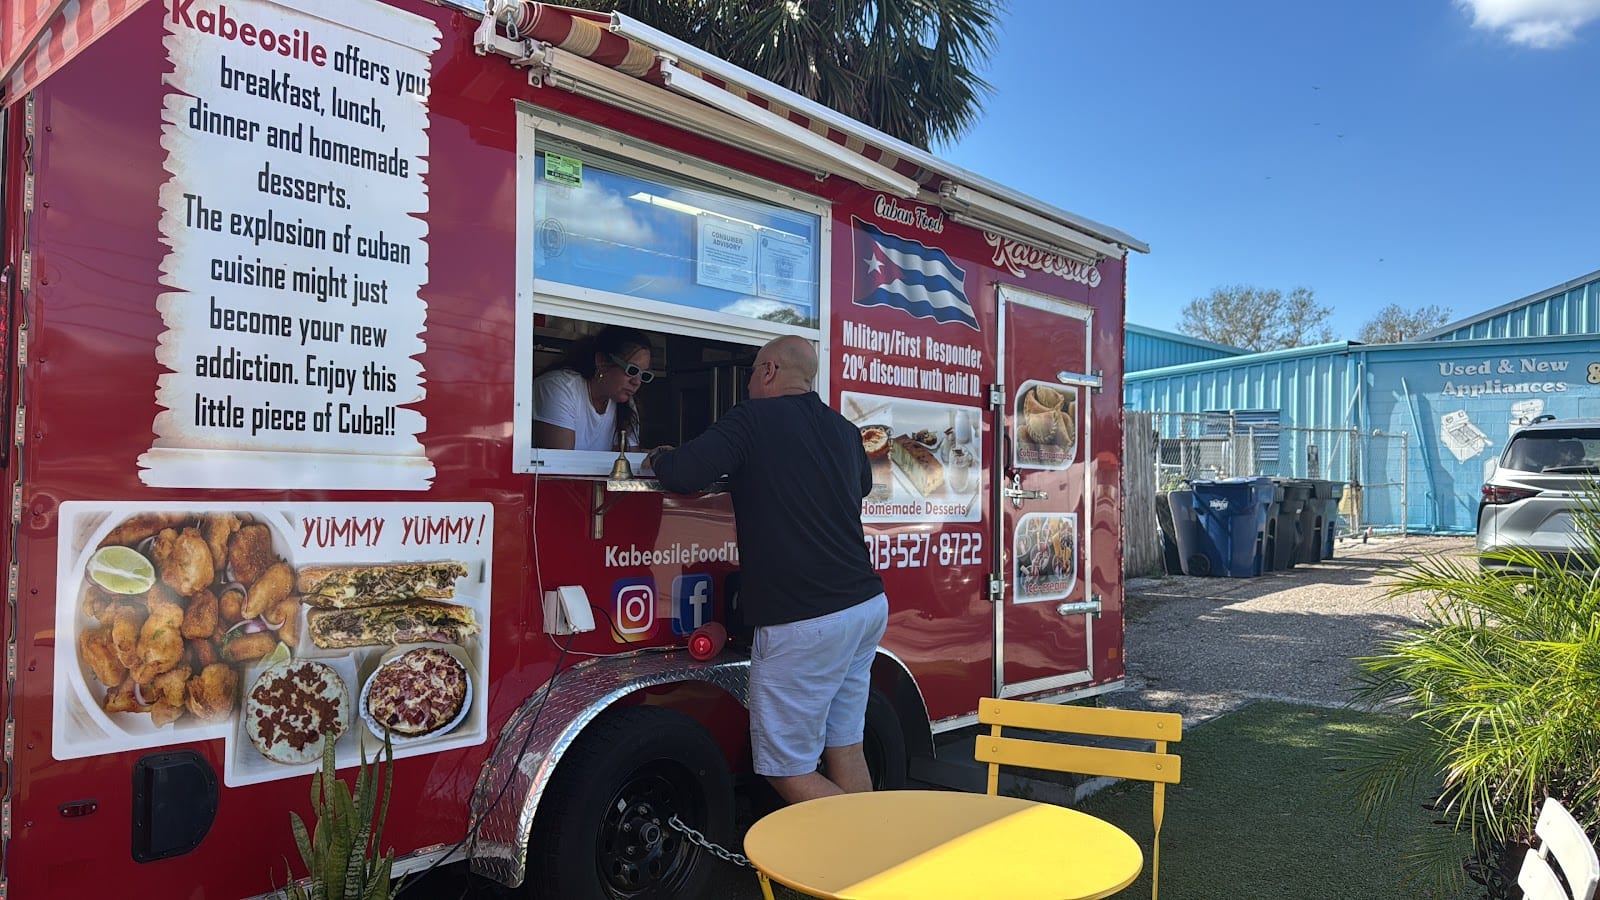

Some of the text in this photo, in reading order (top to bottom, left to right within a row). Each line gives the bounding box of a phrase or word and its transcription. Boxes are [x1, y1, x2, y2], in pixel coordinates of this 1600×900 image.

[172, 0, 426, 97] Kabeosile offers you
[220, 55, 386, 133] breakfast, lunch,
[189, 98, 409, 179] dinner and homemade
[257, 161, 351, 209] desserts.
[183, 193, 411, 265] The explosion of cuban
[874, 194, 944, 234] Cuban Food
[712, 231, 743, 245] CONSUMER
[712, 239, 741, 251] ADVISORY
[210, 255, 388, 307] cuisine might just
[210, 296, 387, 348] become your new
[195, 345, 397, 396] addiction. Enjoy this
[842, 353, 868, 381] 20%
[869, 358, 919, 389] discount
[919, 368, 942, 392] with
[944, 371, 969, 396] valid
[925, 336, 983, 371] Responder,
[1439, 357, 1569, 376] Used & New
[1441, 379, 1568, 398] Appliances
[195, 392, 396, 436] little piece of Cuba!!
[925, 501, 967, 515] Desserts
[302, 514, 486, 548] YUMMY YUMMY!
